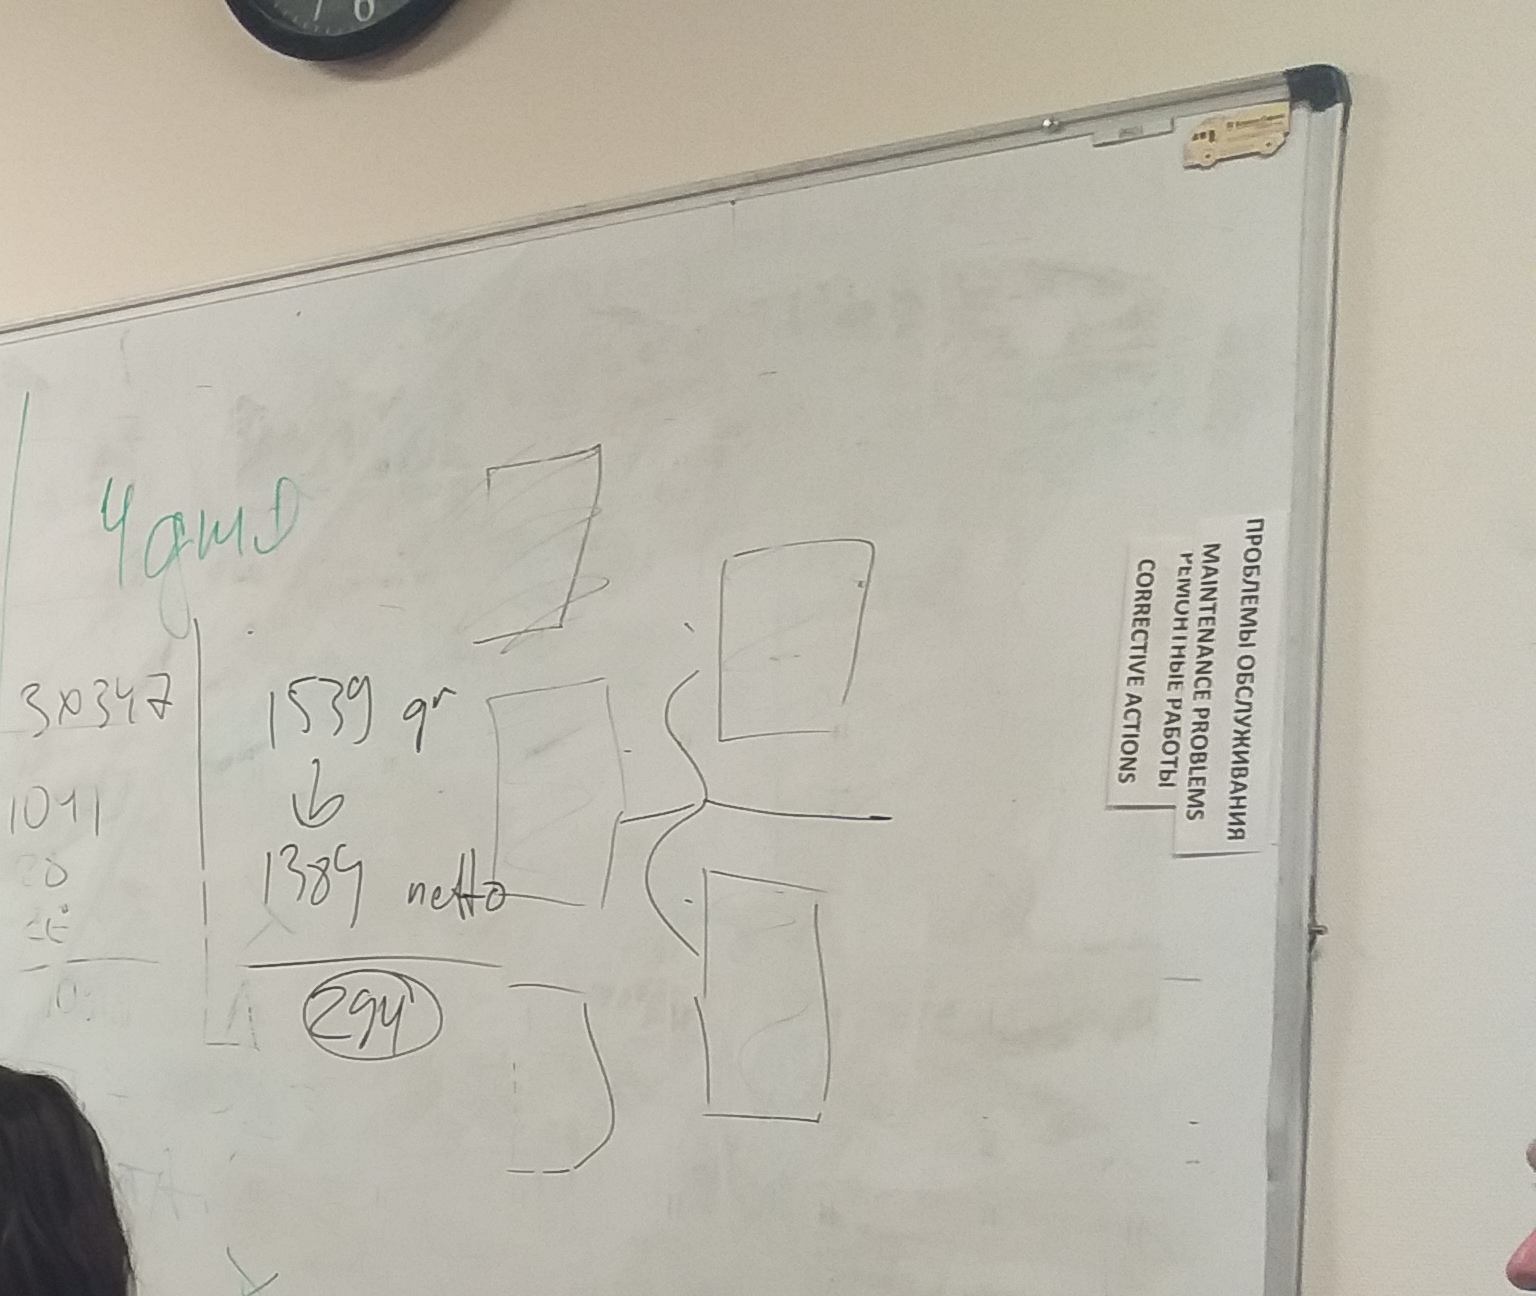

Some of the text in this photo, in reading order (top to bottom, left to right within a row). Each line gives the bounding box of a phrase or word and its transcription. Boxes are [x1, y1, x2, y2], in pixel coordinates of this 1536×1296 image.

[1118, 559, 1155, 784] CORRECTIVE ACTIONS
[1158, 698, 1183, 788] РАБОТЫ
[1186, 543, 1221, 821] MAINTENANCE PROBLEMS
[1227, 518, 1265, 841] ПРОБЛЕМЫ ОБСЛУЖИВАНИЯ
[408, 847, 506, 921] netto
[309, 985, 406, 1057] 294
